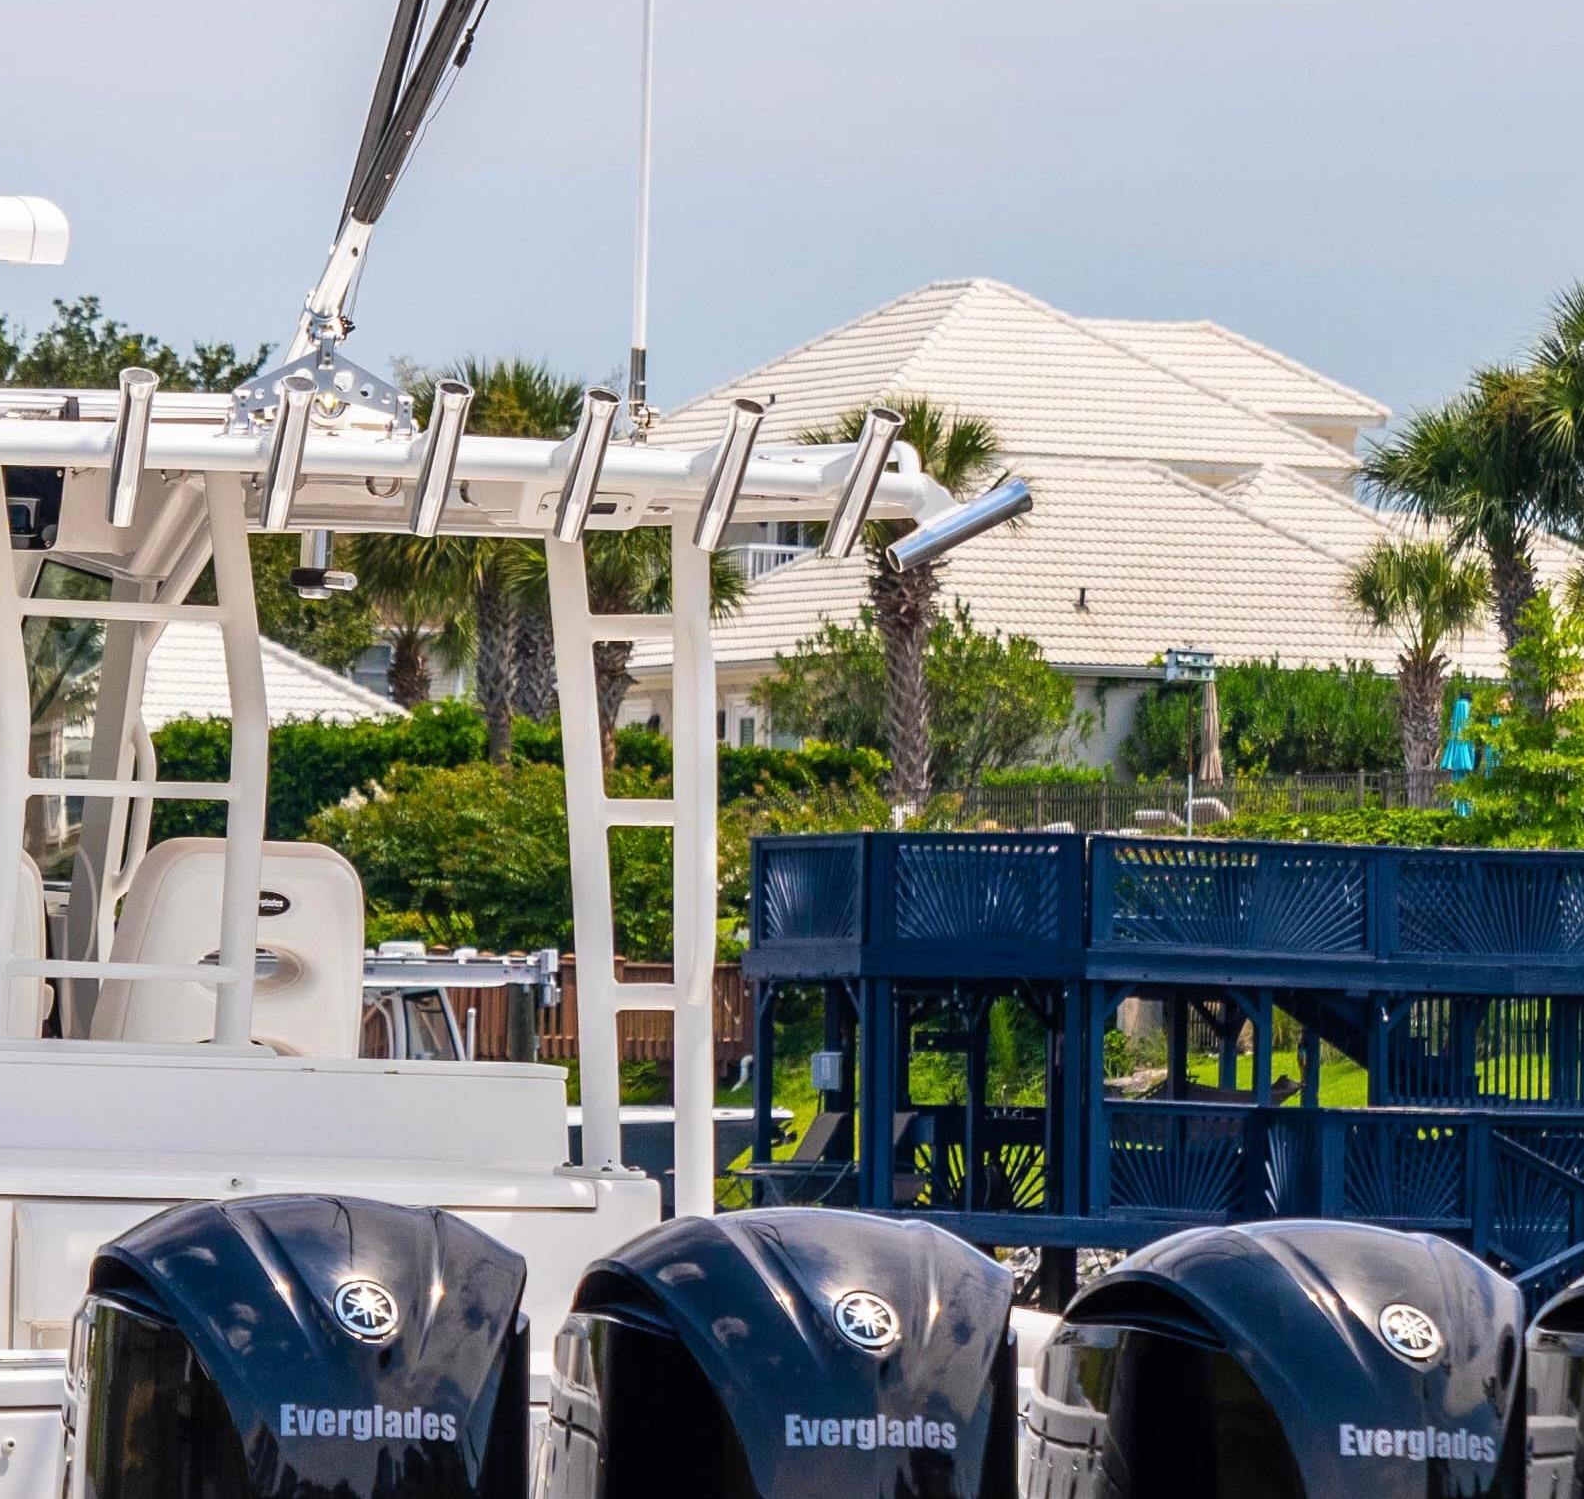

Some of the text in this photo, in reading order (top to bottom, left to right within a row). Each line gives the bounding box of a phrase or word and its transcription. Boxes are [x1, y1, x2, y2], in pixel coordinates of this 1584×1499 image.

[280, 1404, 457, 1442] Everglades
[785, 1414, 957, 1450] Everglades
[1339, 1424, 1497, 1463] Everglades
